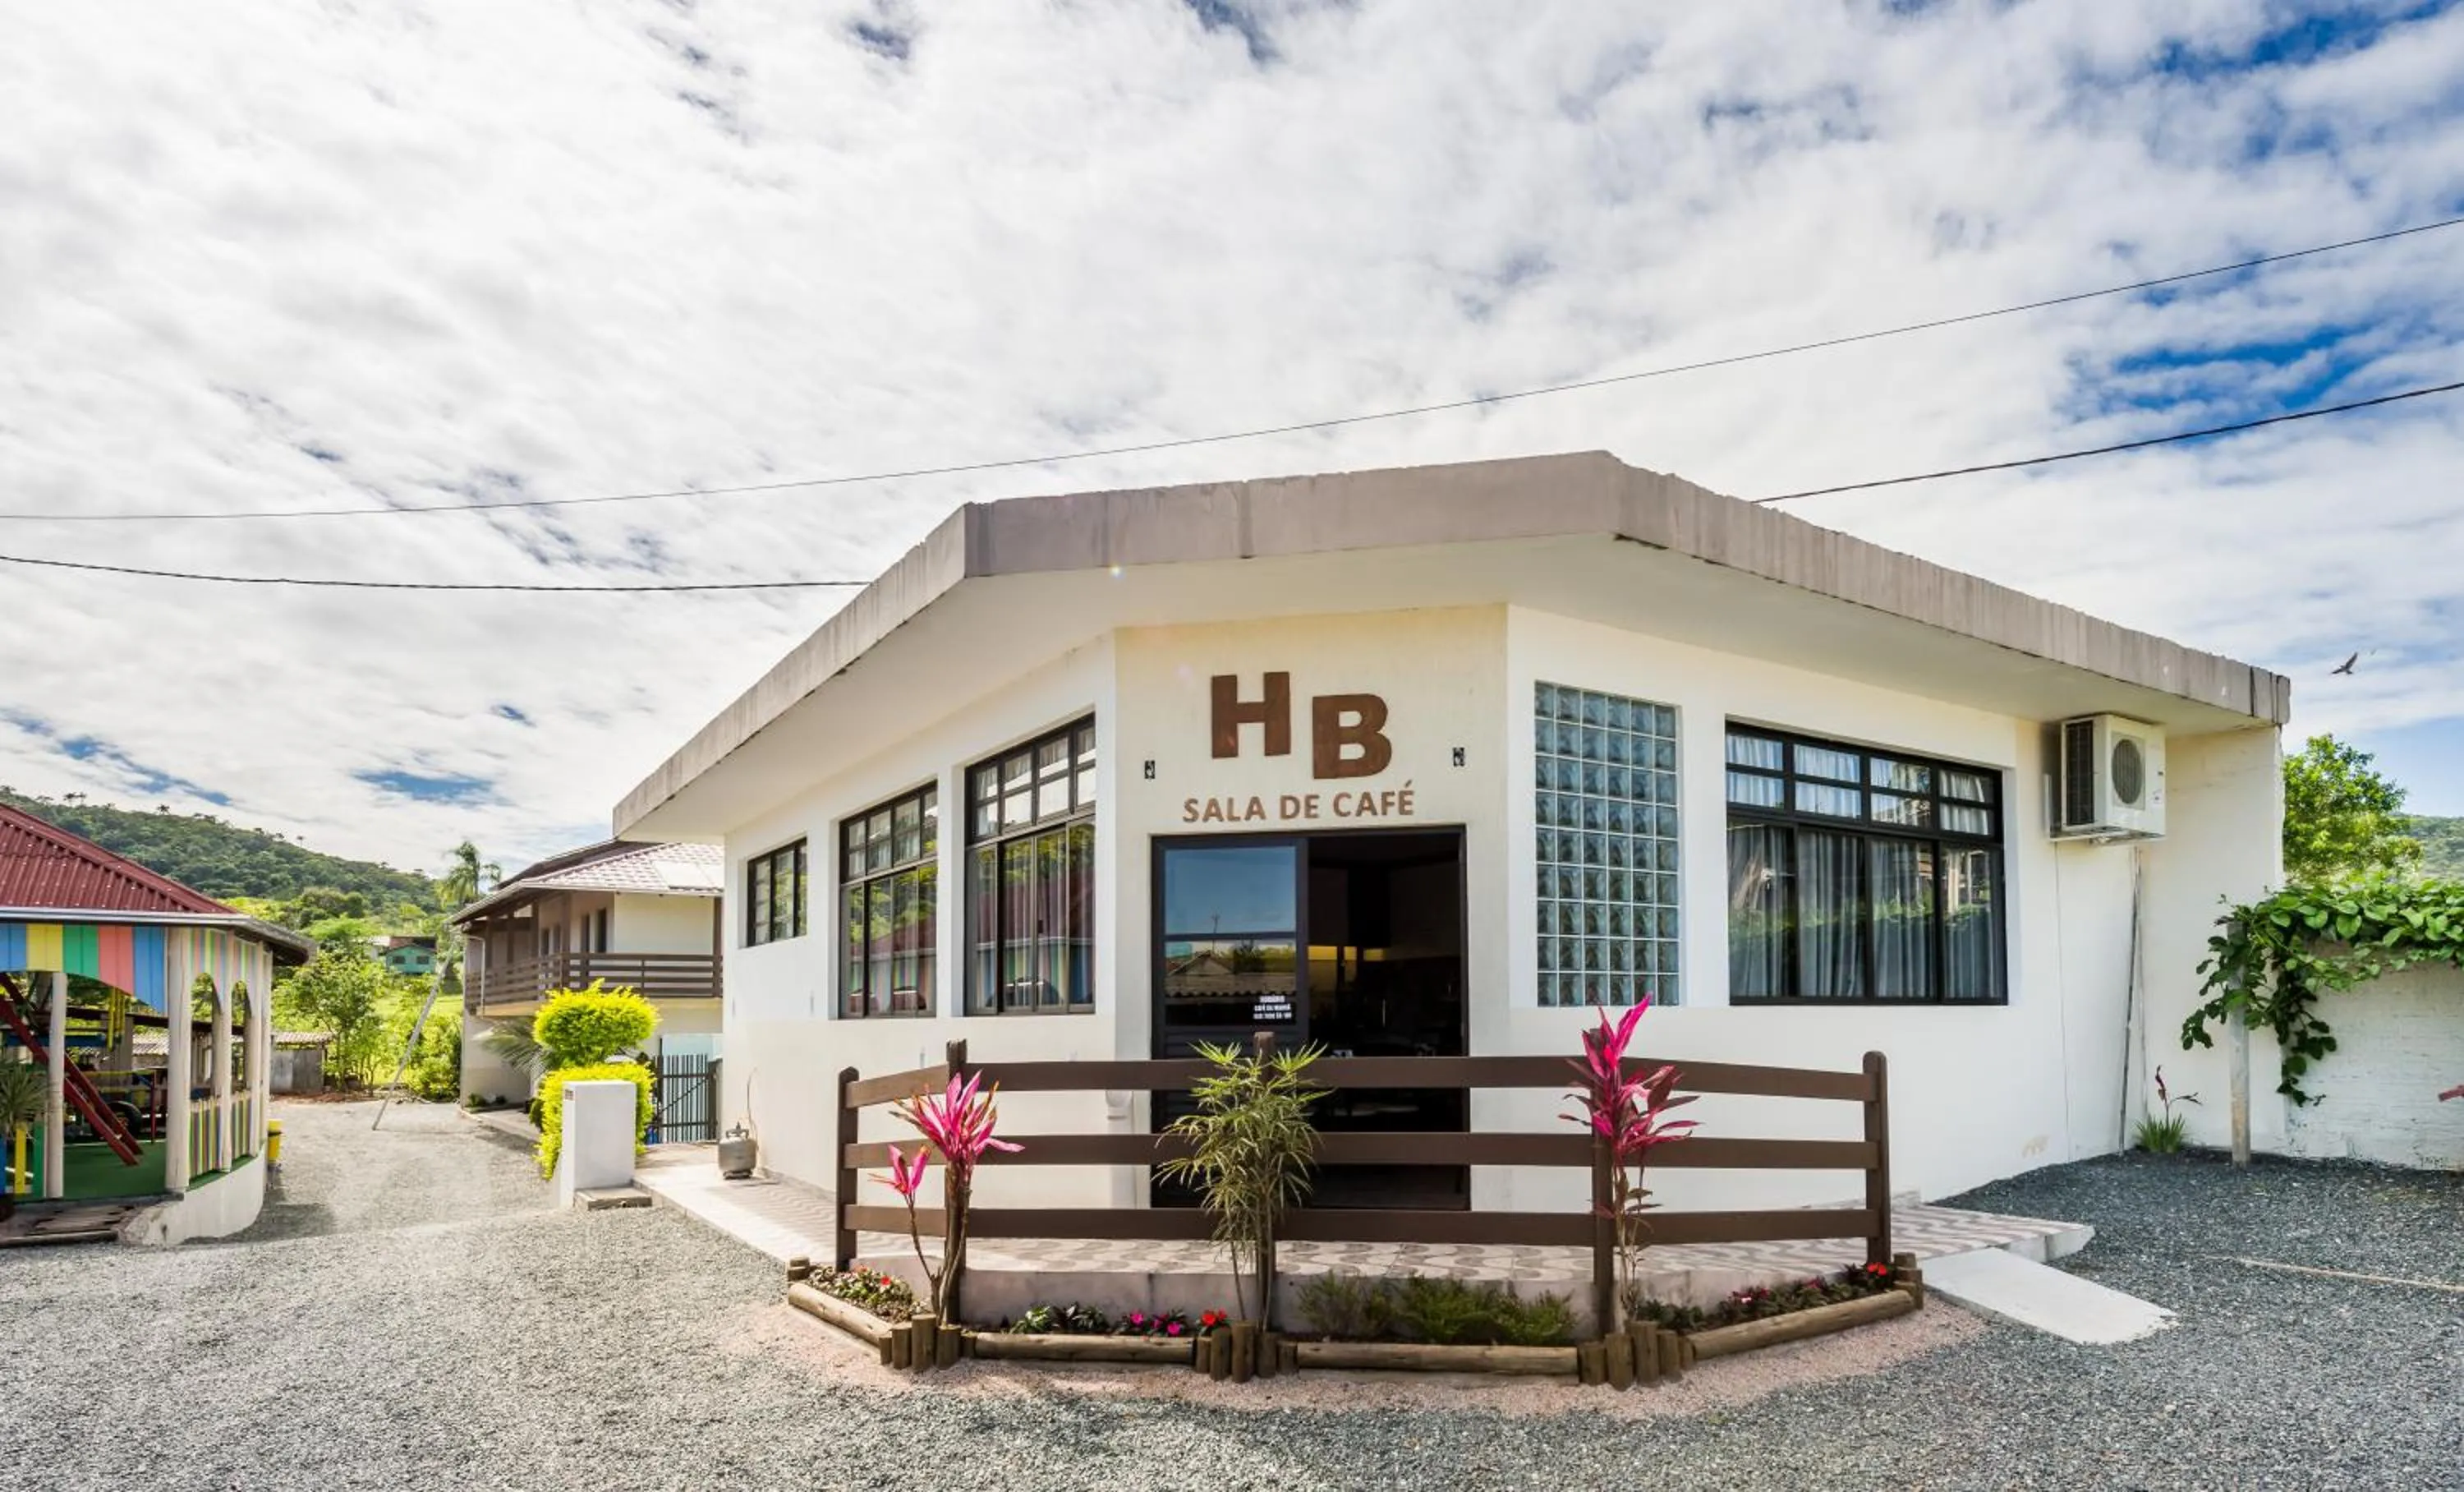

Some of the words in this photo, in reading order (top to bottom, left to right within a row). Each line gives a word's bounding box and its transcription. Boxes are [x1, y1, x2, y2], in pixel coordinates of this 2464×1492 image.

[1183, 796, 1266, 822] SALA
[1280, 794, 1320, 820] DE
[1333, 780, 1414, 817] CAFÉ
